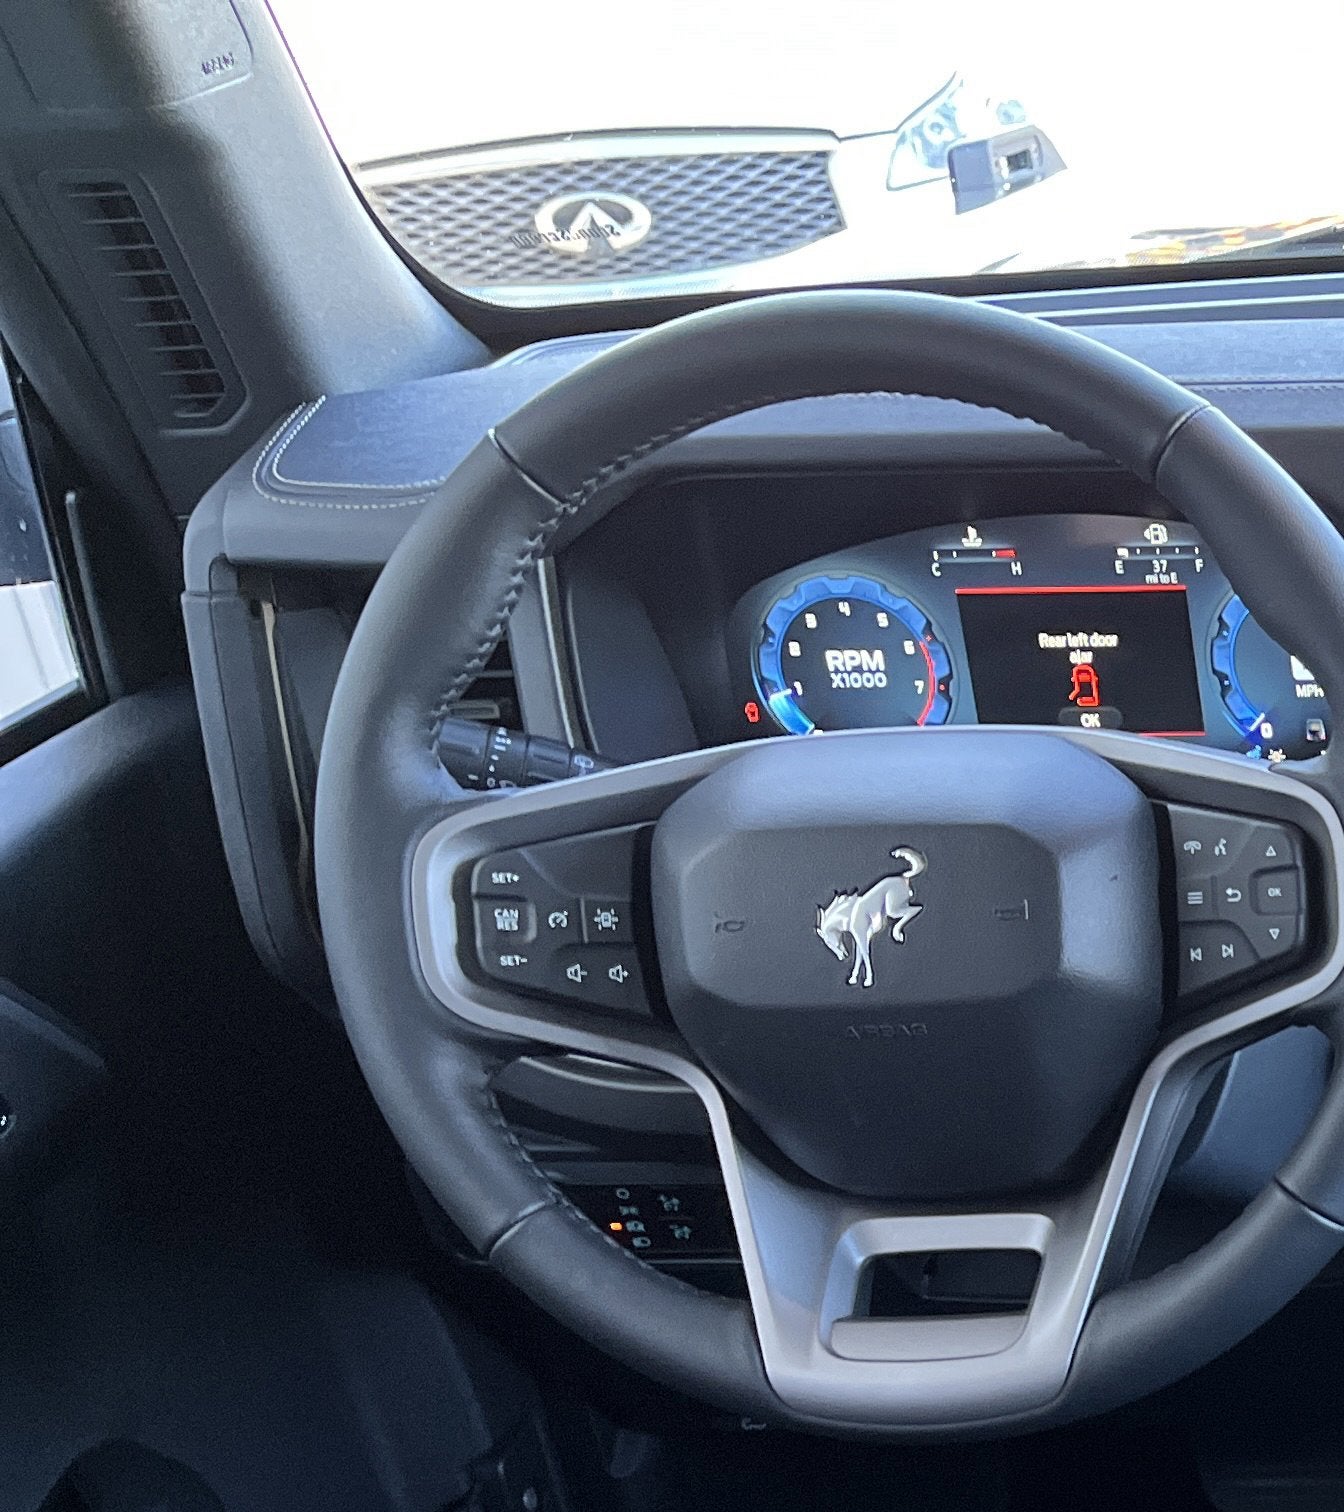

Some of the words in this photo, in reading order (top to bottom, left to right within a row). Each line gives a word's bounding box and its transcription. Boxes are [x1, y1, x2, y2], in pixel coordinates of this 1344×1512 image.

[931, 562, 942, 577] C
[1011, 561, 1022, 576] H
[1115, 560, 1125, 574] E
[1152, 560, 1167, 573] 37
[1195, 558, 1204, 572] F
[837, 601, 851, 616] 4
[876, 612, 889, 628] 5
[903, 640, 915, 655] 6
[1038, 632, 1067, 648] Rear
[1067, 632, 1089, 648] left
[1090, 632, 1118, 648] door
[825, 649, 886, 672] RPM
[1069, 649, 1093, 666] ajar
[793, 680, 803, 696] 1
[830, 672, 888, 689] X1000
[914, 680, 925, 695] 7
[1080, 713, 1101, 728] OK
[1260, 722, 1274, 739] 0
[1267, 887, 1282, 897] OK
[494, 908, 519, 919] CAN
